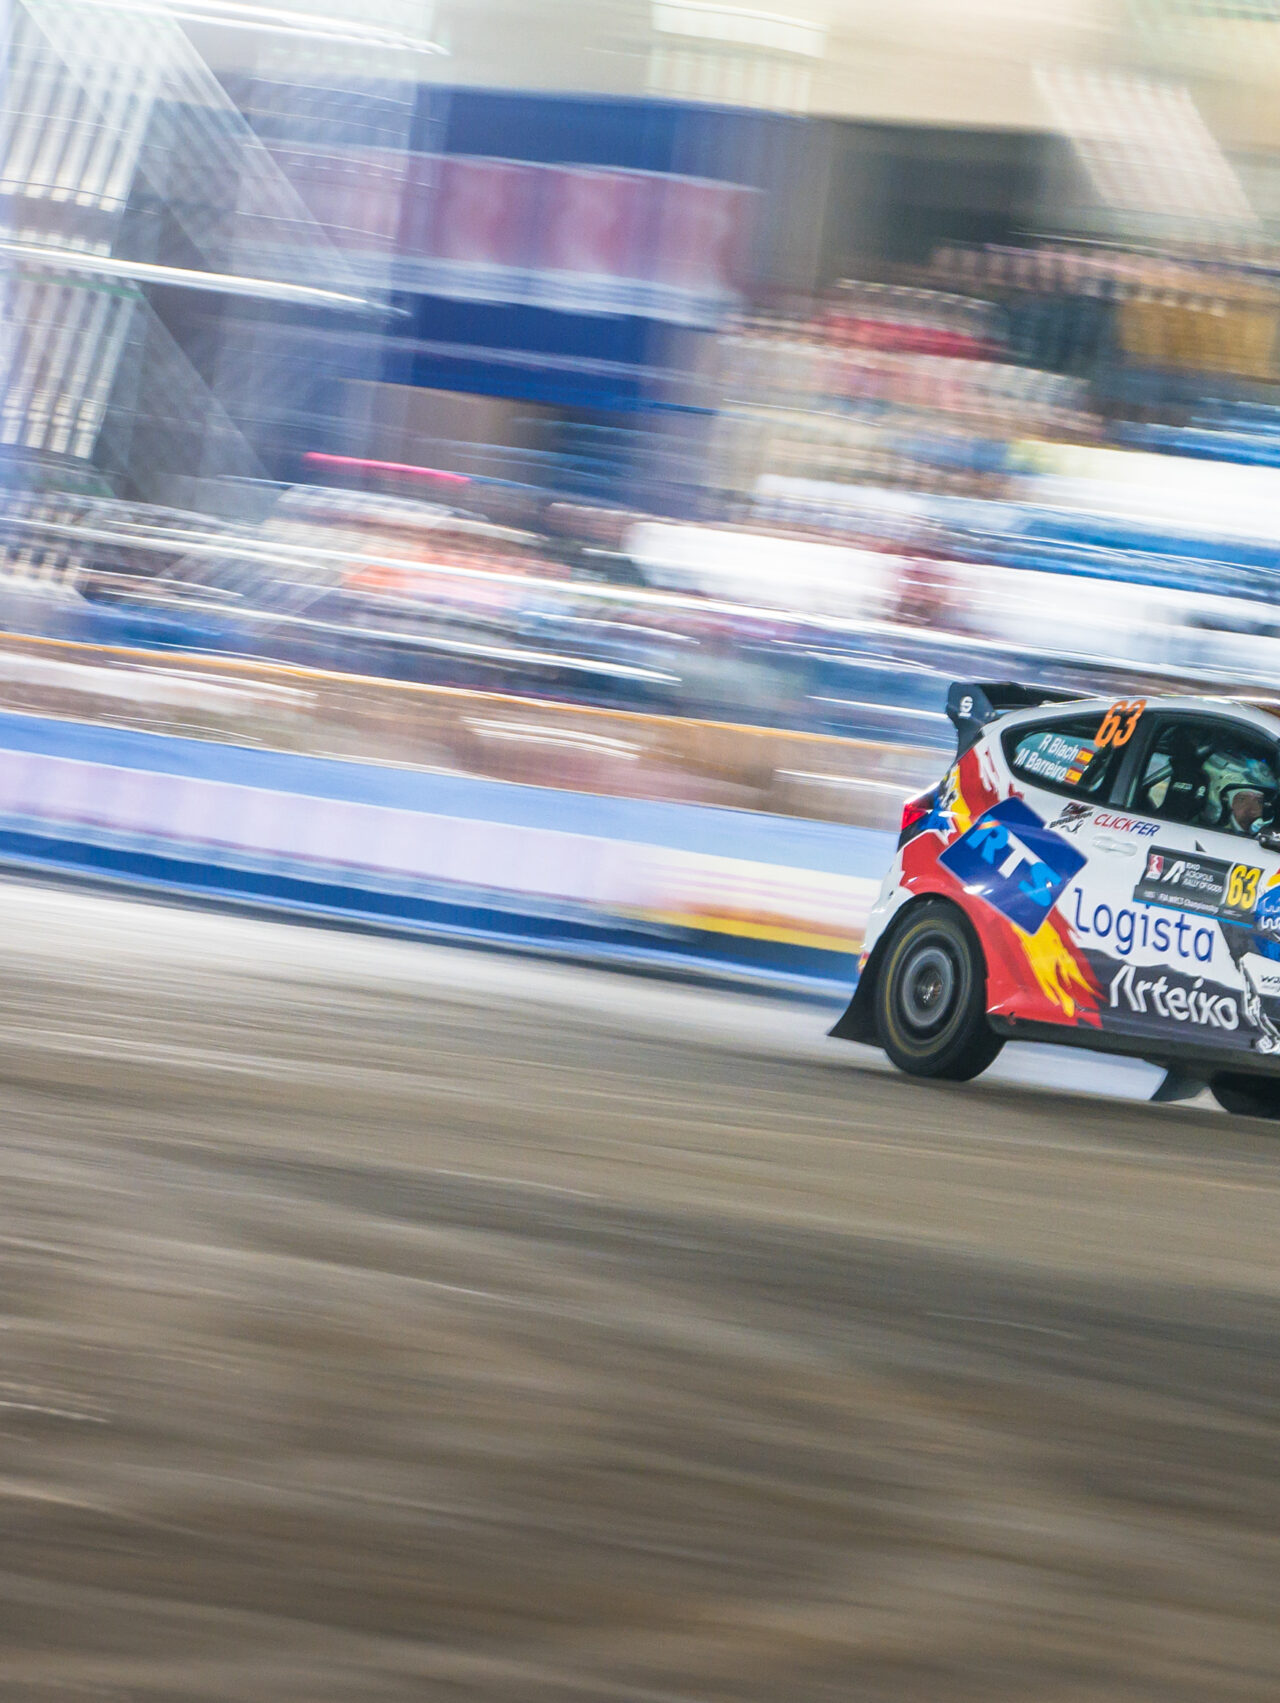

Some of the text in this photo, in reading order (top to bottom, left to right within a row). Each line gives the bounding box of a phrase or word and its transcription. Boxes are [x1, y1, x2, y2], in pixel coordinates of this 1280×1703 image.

[1094, 699, 1147, 747] 63
[1013, 748, 1067, 782] M Barreiro
[1039, 734, 1080, 761] R Blach
[1094, 813, 1160, 836] CLICKFER
[966, 814, 1062, 907] RTS
[1226, 865, 1261, 910] 63
[1109, 964, 1239, 1031] Arteixo
